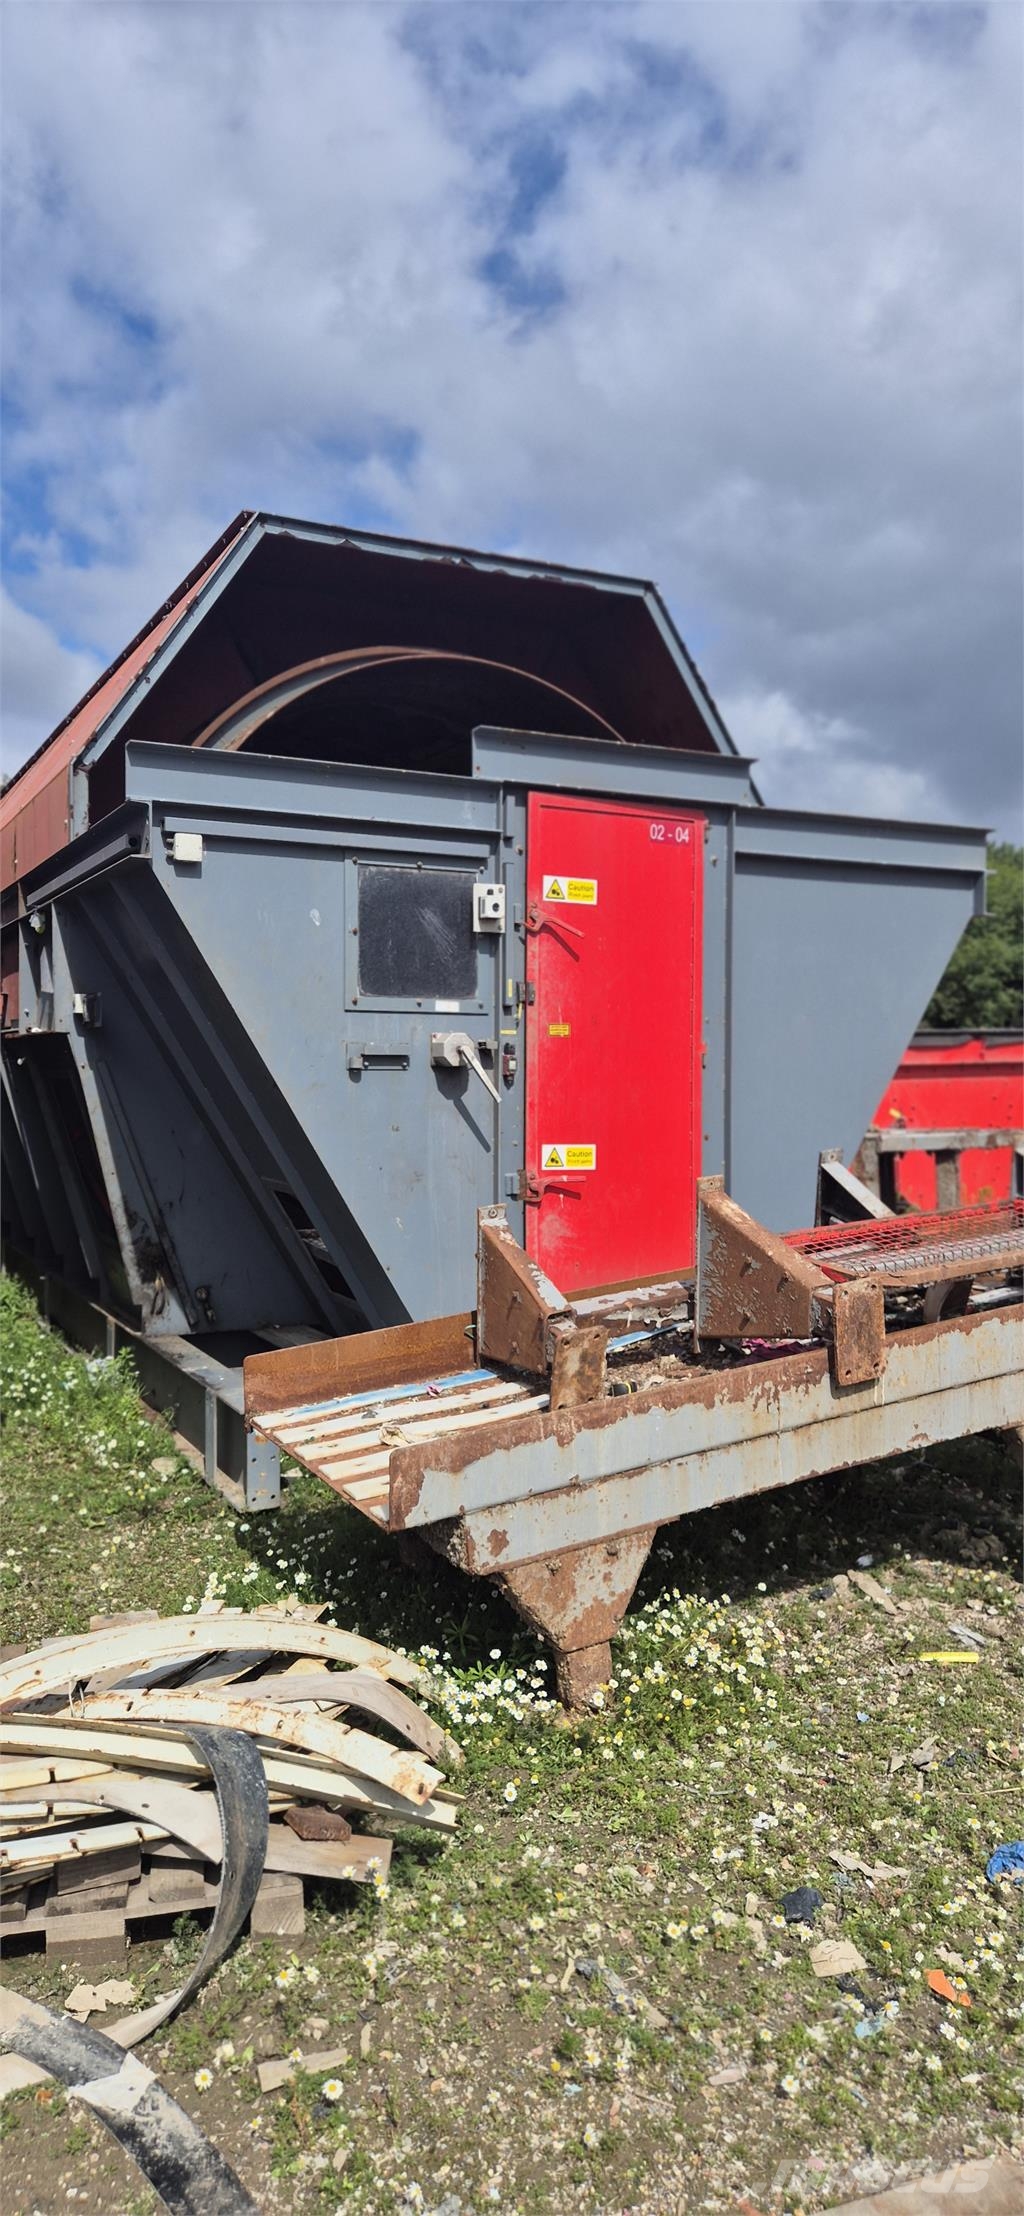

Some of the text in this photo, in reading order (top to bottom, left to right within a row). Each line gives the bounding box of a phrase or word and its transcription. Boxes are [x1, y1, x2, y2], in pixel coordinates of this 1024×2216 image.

[650, 823, 665, 841] 02
[675, 826, 690, 843] 04
[568, 882, 594, 892] Caution
[567, 1150, 593, 1158] Caution
